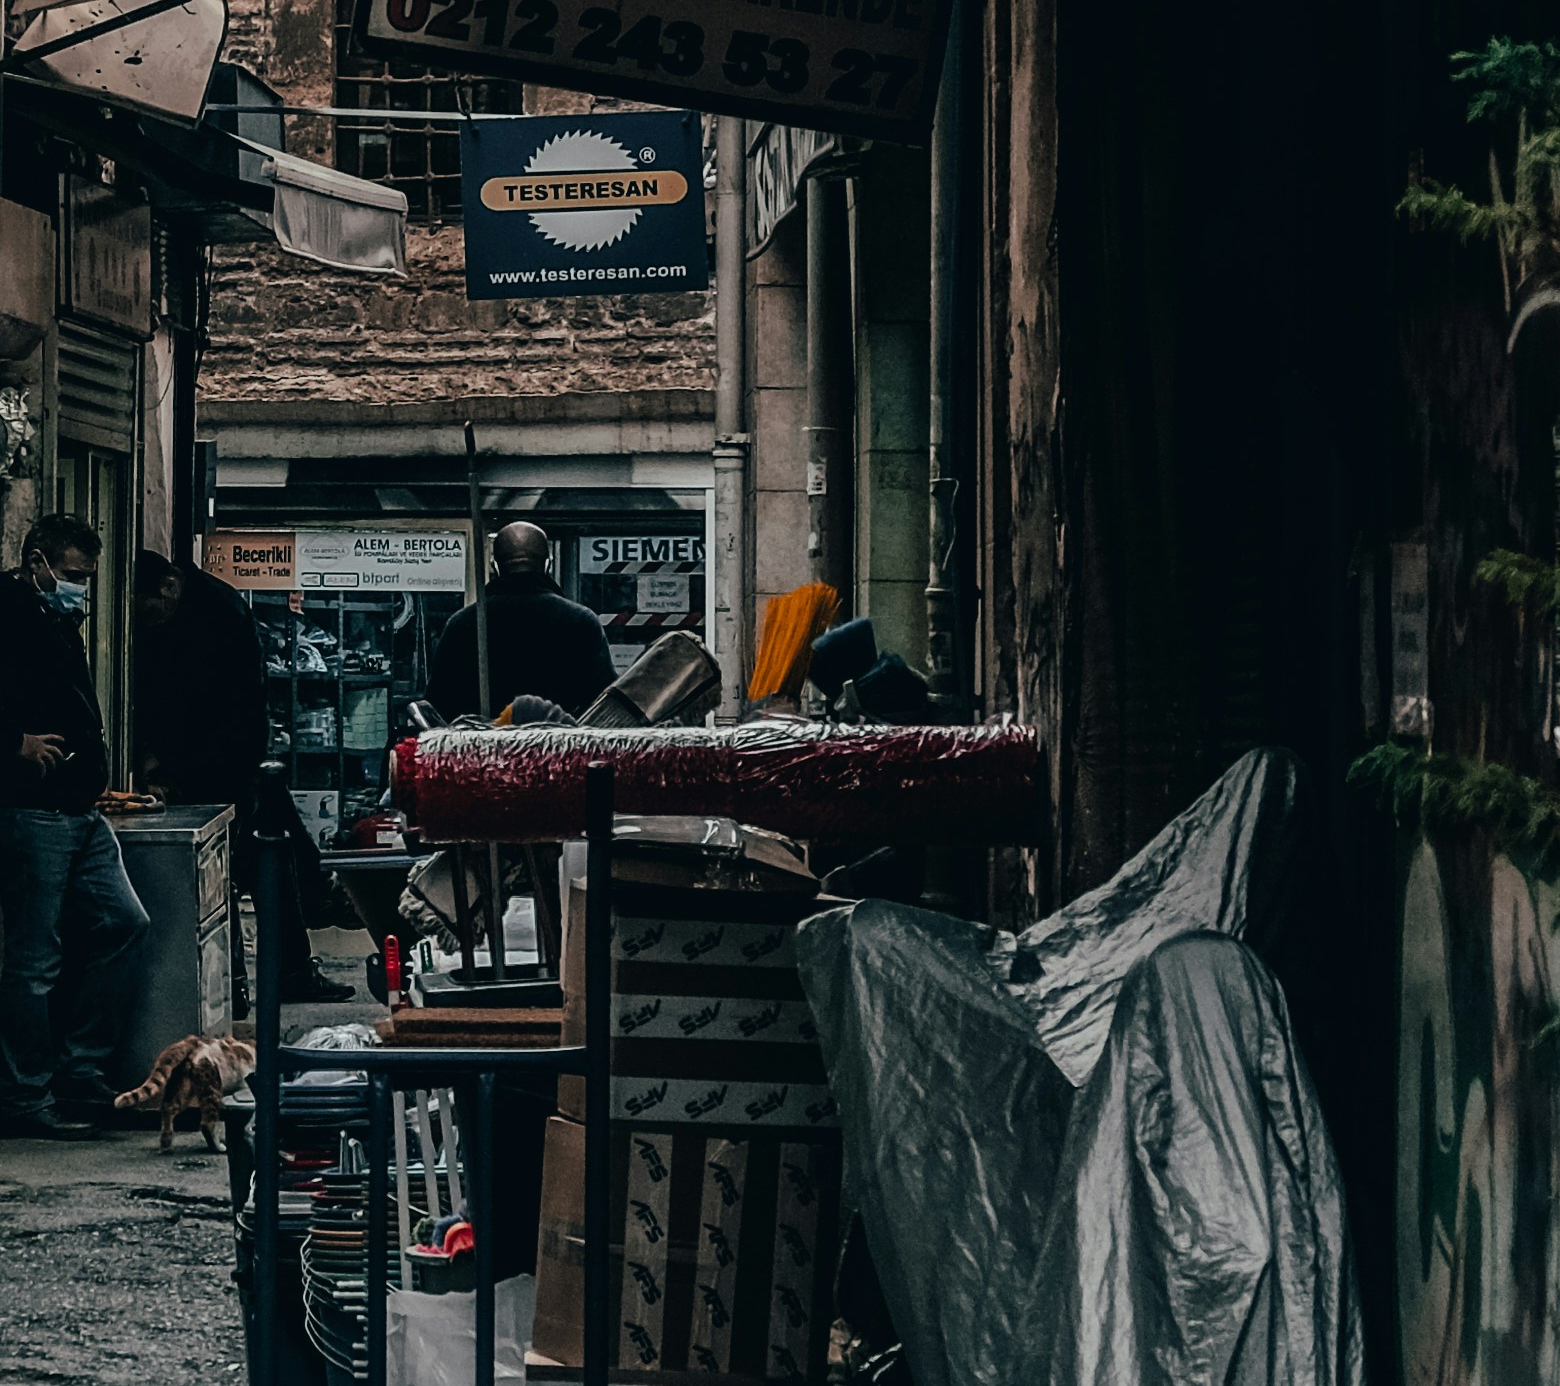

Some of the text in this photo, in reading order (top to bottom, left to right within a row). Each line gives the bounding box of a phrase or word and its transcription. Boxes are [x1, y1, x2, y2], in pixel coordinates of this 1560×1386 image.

[572, 7, 704, 77] 243
[722, 30, 810, 93] 53
[825, 49, 919, 110] 27
[503, 178, 659, 202] TESTERESAN
[488, 262, 688, 285] www.testeresan.com
[232, 545, 292, 563] Becerikli
[353, 538, 390, 551] ALEM
[404, 539, 462, 551] BERTOLA
[232, 566, 260, 576] Ticaret
[268, 566, 291, 577] Trade
